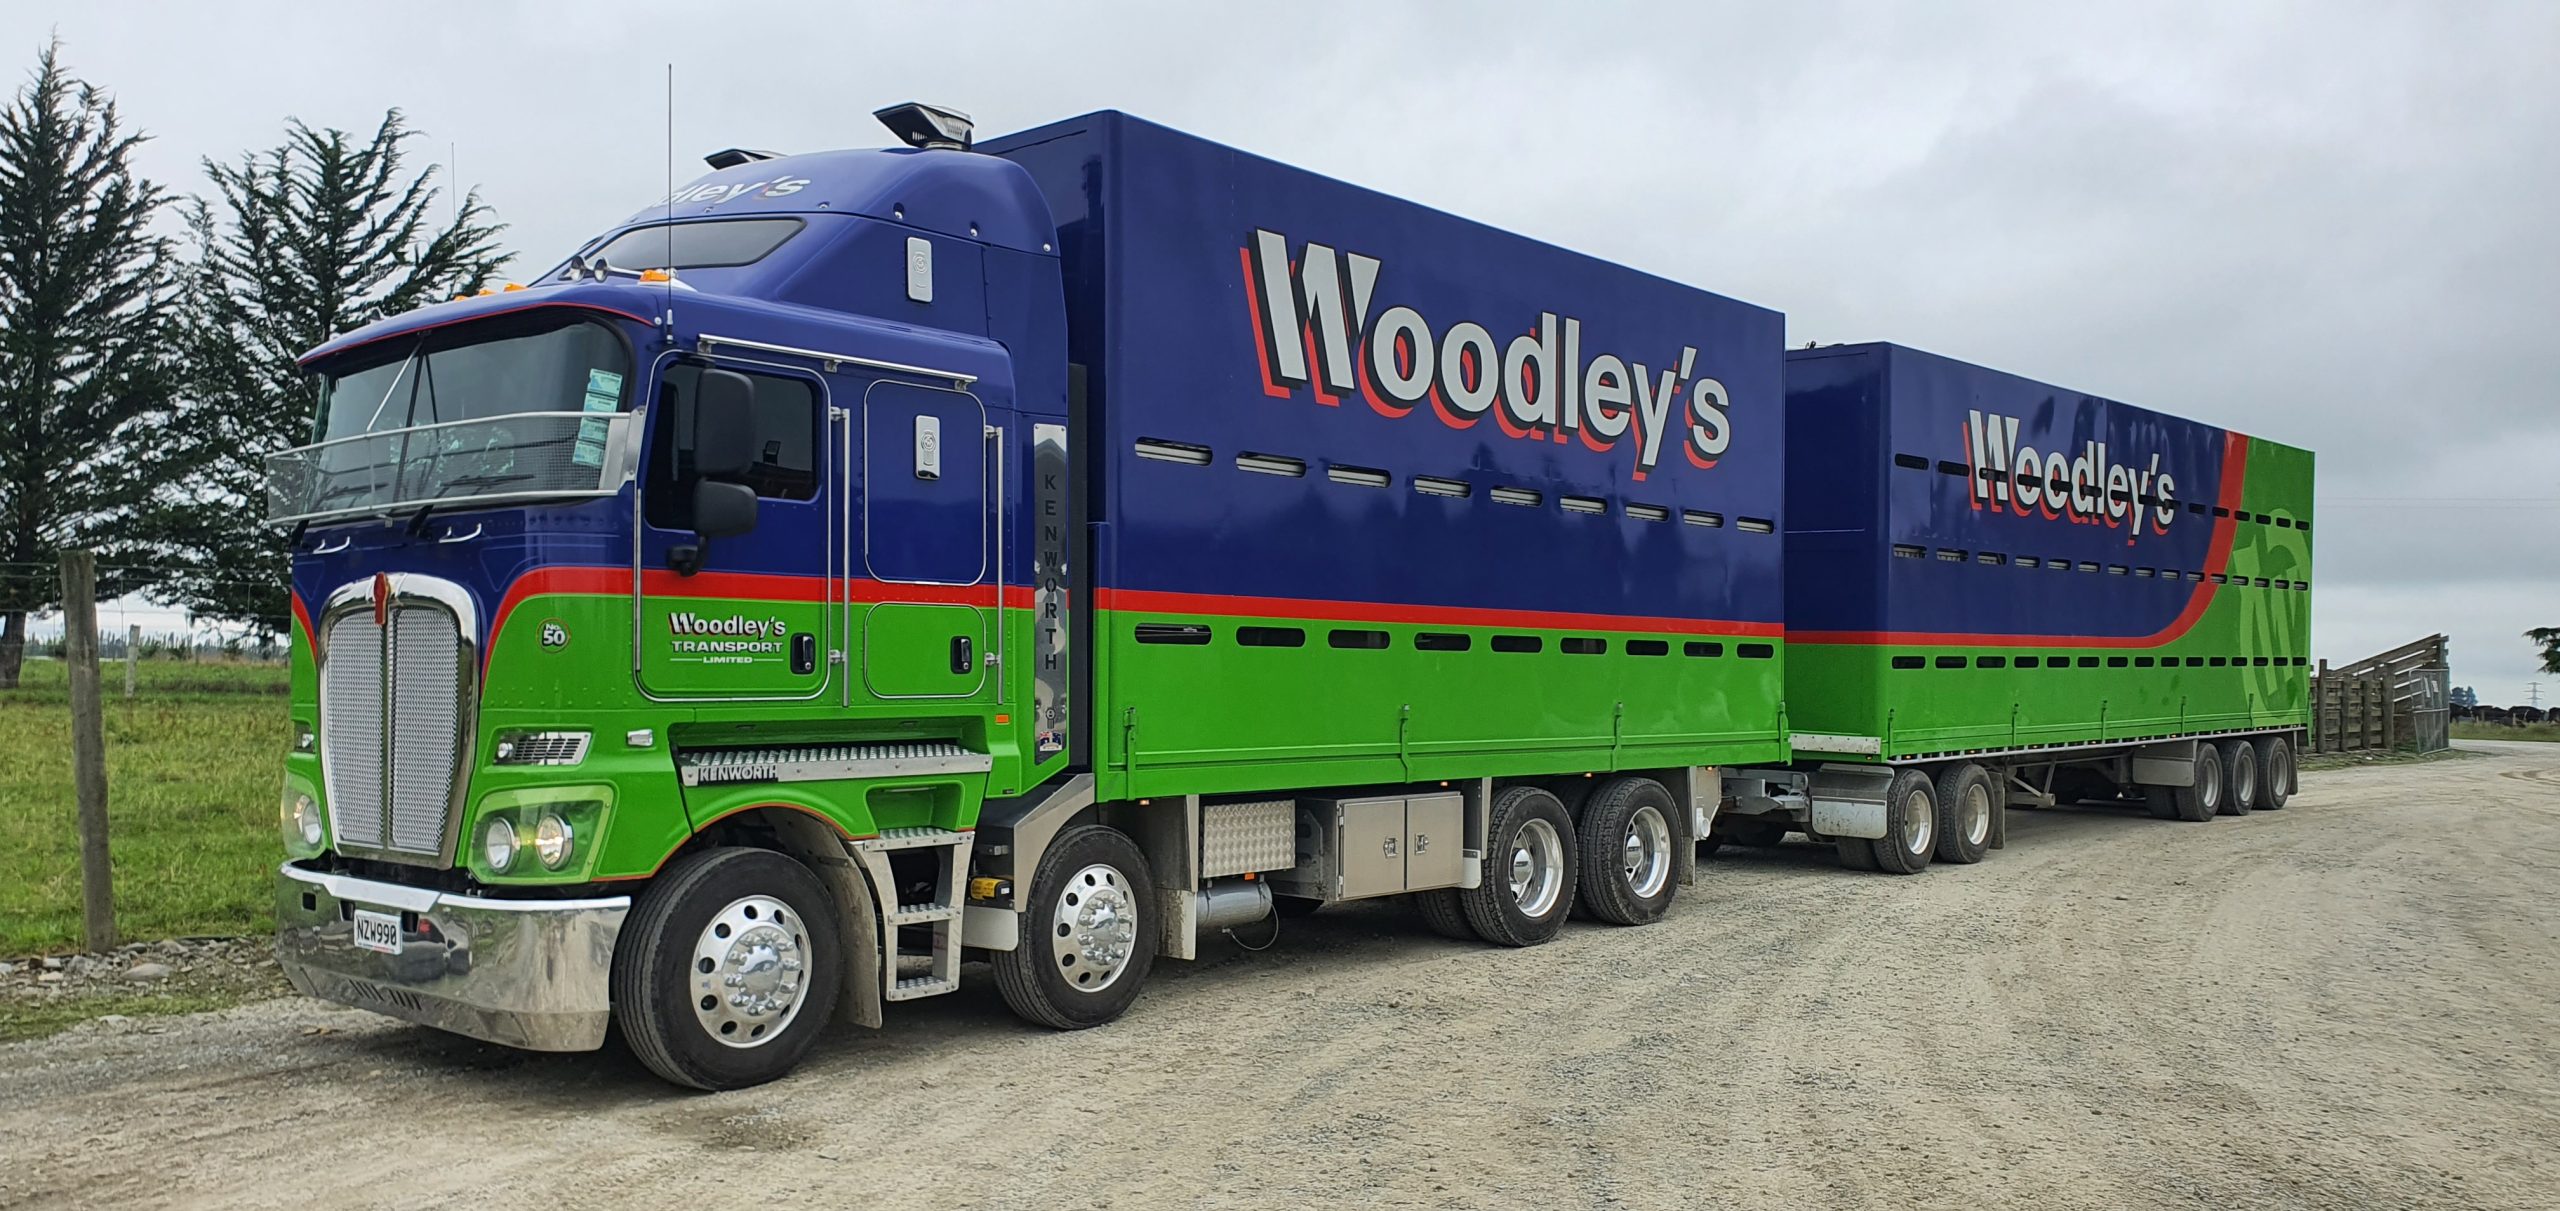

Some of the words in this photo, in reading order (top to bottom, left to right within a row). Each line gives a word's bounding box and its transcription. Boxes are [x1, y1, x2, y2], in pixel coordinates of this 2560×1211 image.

[1240, 227, 1731, 480] Woodley's
[1963, 409, 2176, 545] Woodley's
[1044, 474, 1057, 670] KENWORTH
[543, 630, 566, 645] 50
[669, 612, 786, 640] Woodley's
[671, 641, 783, 653] TRANSPORT
[703, 656, 753, 664] LIMITED
[700, 764, 778, 782] KENWORTH
[358, 918, 396, 945] NZW990
